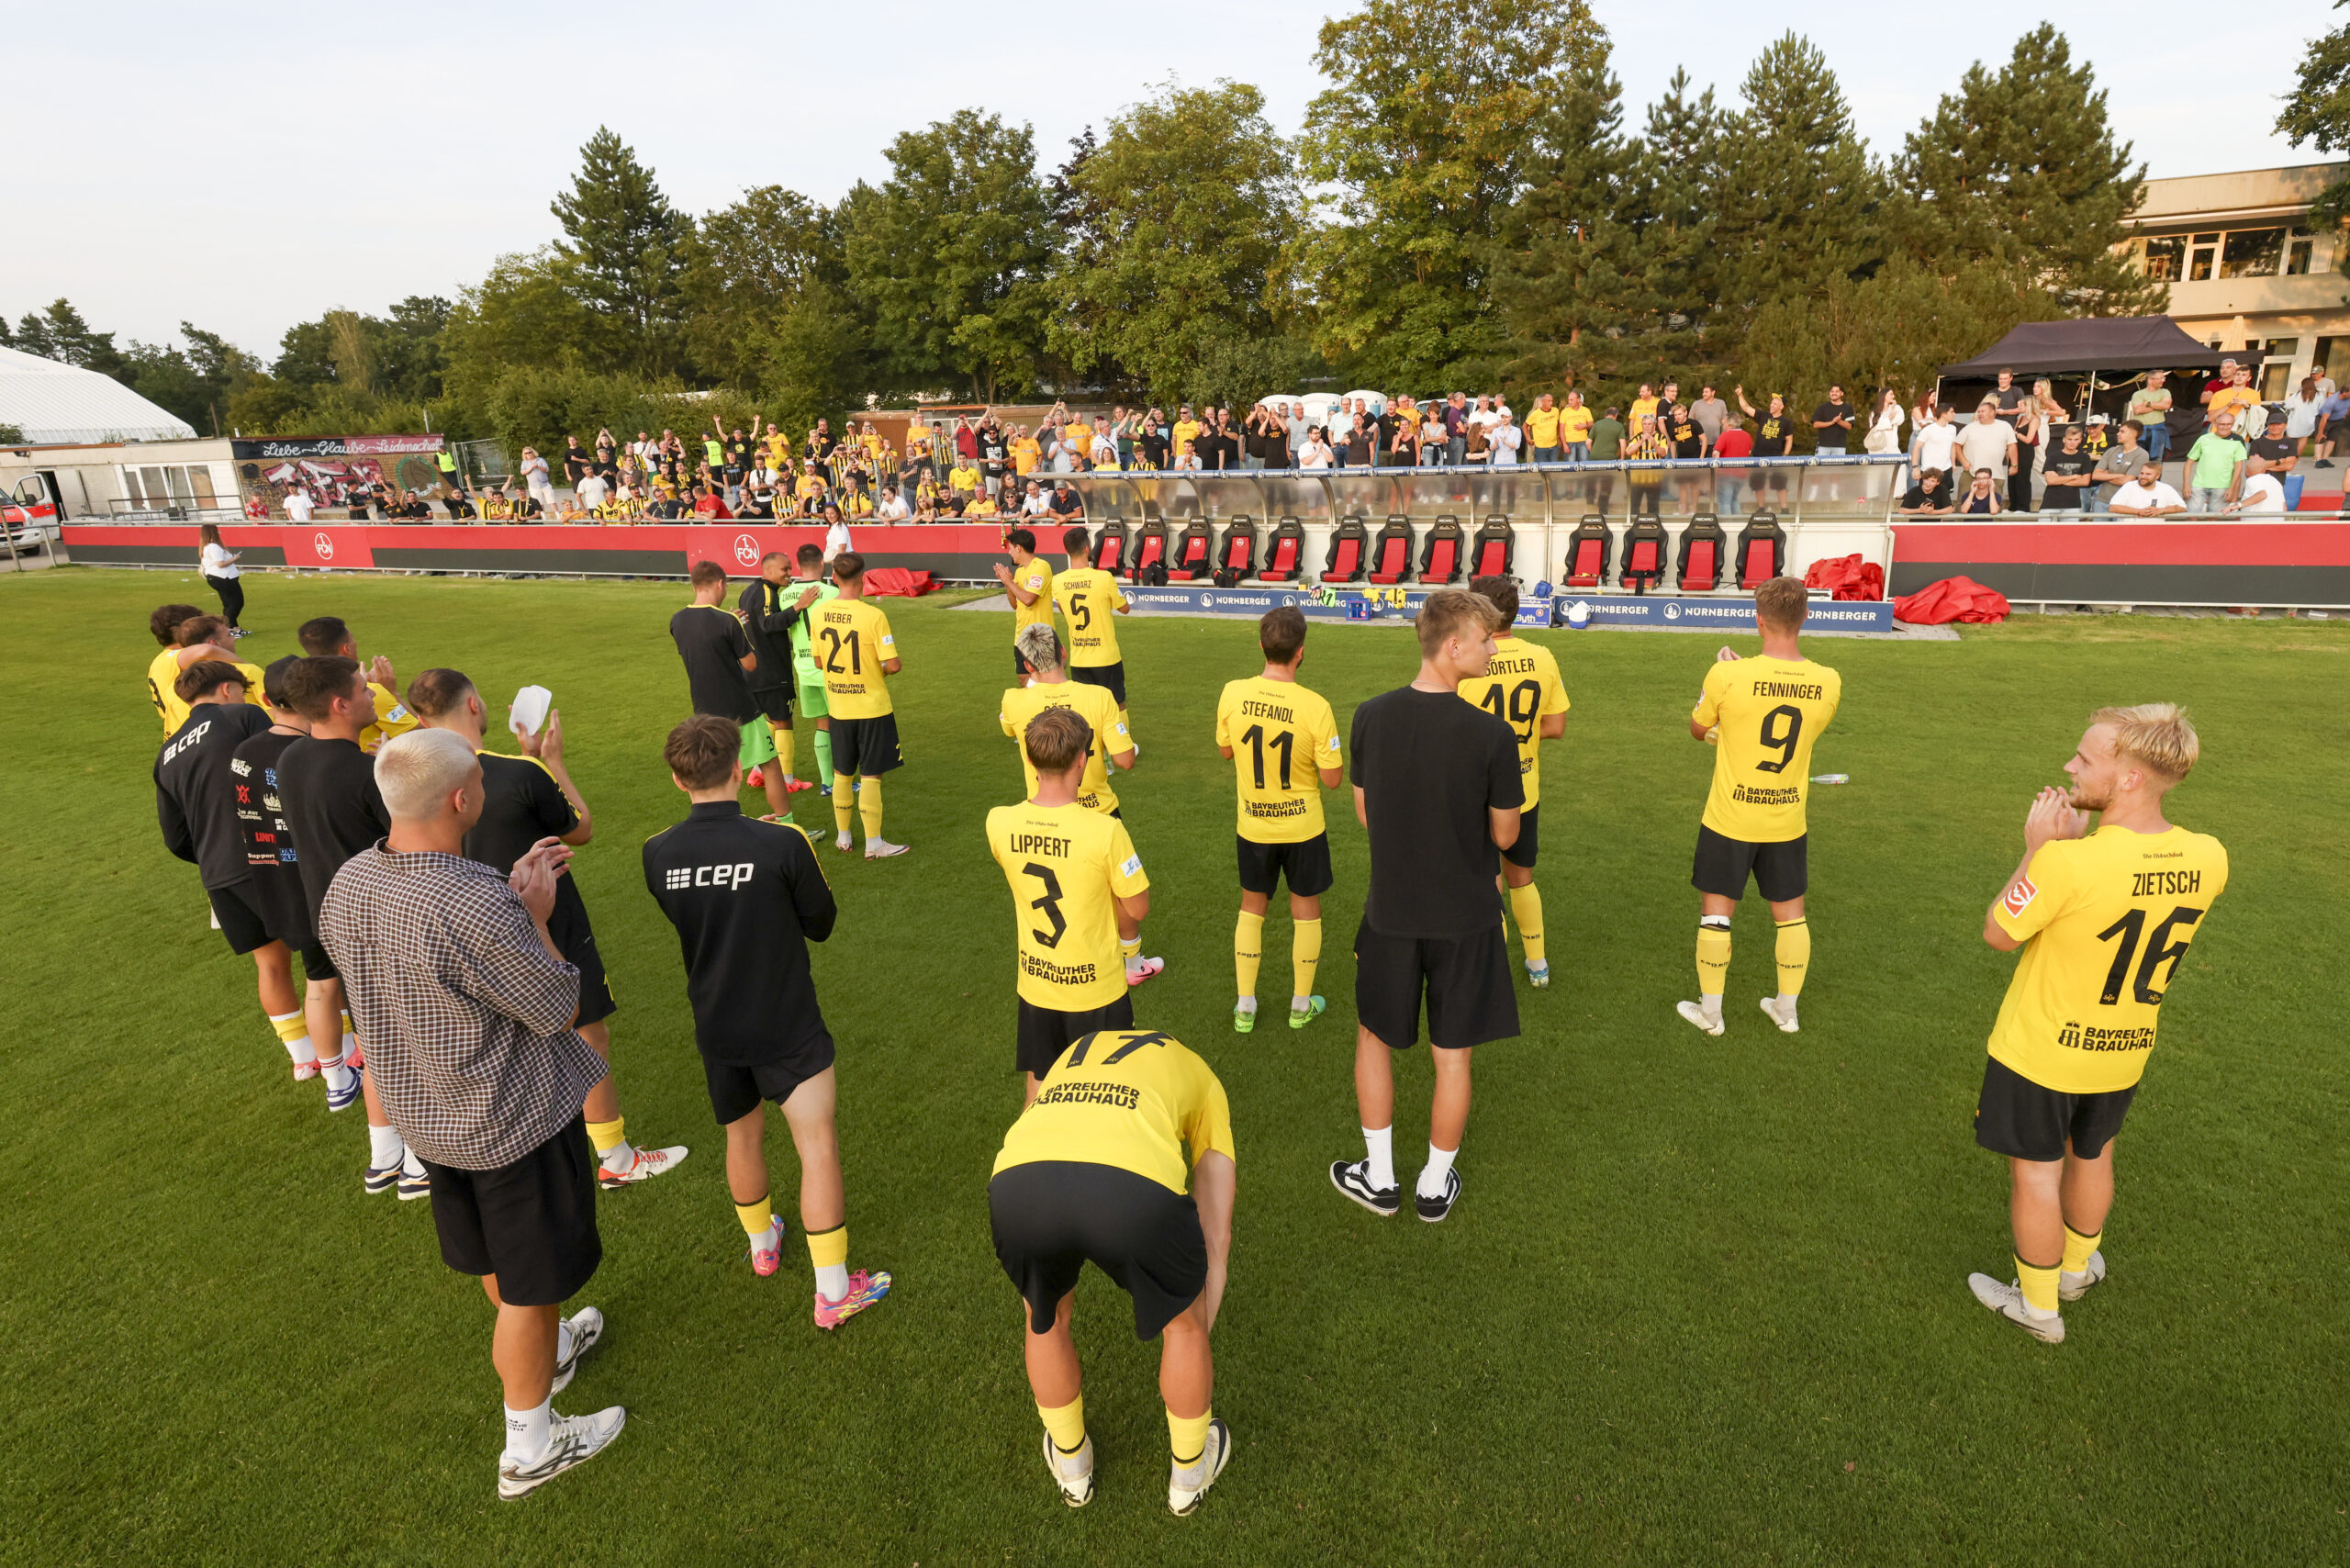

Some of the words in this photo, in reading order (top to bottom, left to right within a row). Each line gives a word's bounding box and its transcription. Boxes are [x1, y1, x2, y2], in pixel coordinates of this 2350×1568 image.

[263, 442, 300, 456] Liebe
[316, 440, 367, 454] Glaube
[737, 548, 757, 559] FCN
[1064, 580, 1091, 590] SCHWARZ
[1138, 594, 1190, 603] NÜRNBERGER
[1216, 597, 1270, 606] NÜRNBERGER
[824, 611, 852, 624] WEBER
[1070, 593, 1091, 631] 5
[1807, 610, 1876, 621] ÜRNBERGER
[820, 627, 861, 675] 21
[1753, 681, 1822, 700] FENNINGER
[1242, 700, 1294, 724] STEFANDL
[1481, 679, 1541, 744] 19
[178, 720, 211, 753] cep
[1755, 704, 1803, 774] 9
[1241, 723, 1294, 790] 11
[1746, 795, 1800, 805] BRAUHAUS
[1747, 787, 1798, 796] BAYREUTHER
[1252, 799, 1305, 810] BAYREUTHER
[1252, 805, 1306, 817] BRAUHAUS
[1011, 834, 1071, 858] LIPPERT
[695, 862, 754, 891] cep
[2132, 870, 2200, 896] ZIETSCH
[1022, 861, 1067, 949] 3
[2096, 906, 2204, 1005] 16
[1029, 956, 1095, 975] BAYREUTHER
[1027, 967, 1096, 985] BRAUHAUS
[2085, 1026, 2155, 1039] BAYREUTH
[1046, 1082, 1140, 1098] BAYREUTHER
[1039, 1092, 1137, 1110] BRAUHAUS
